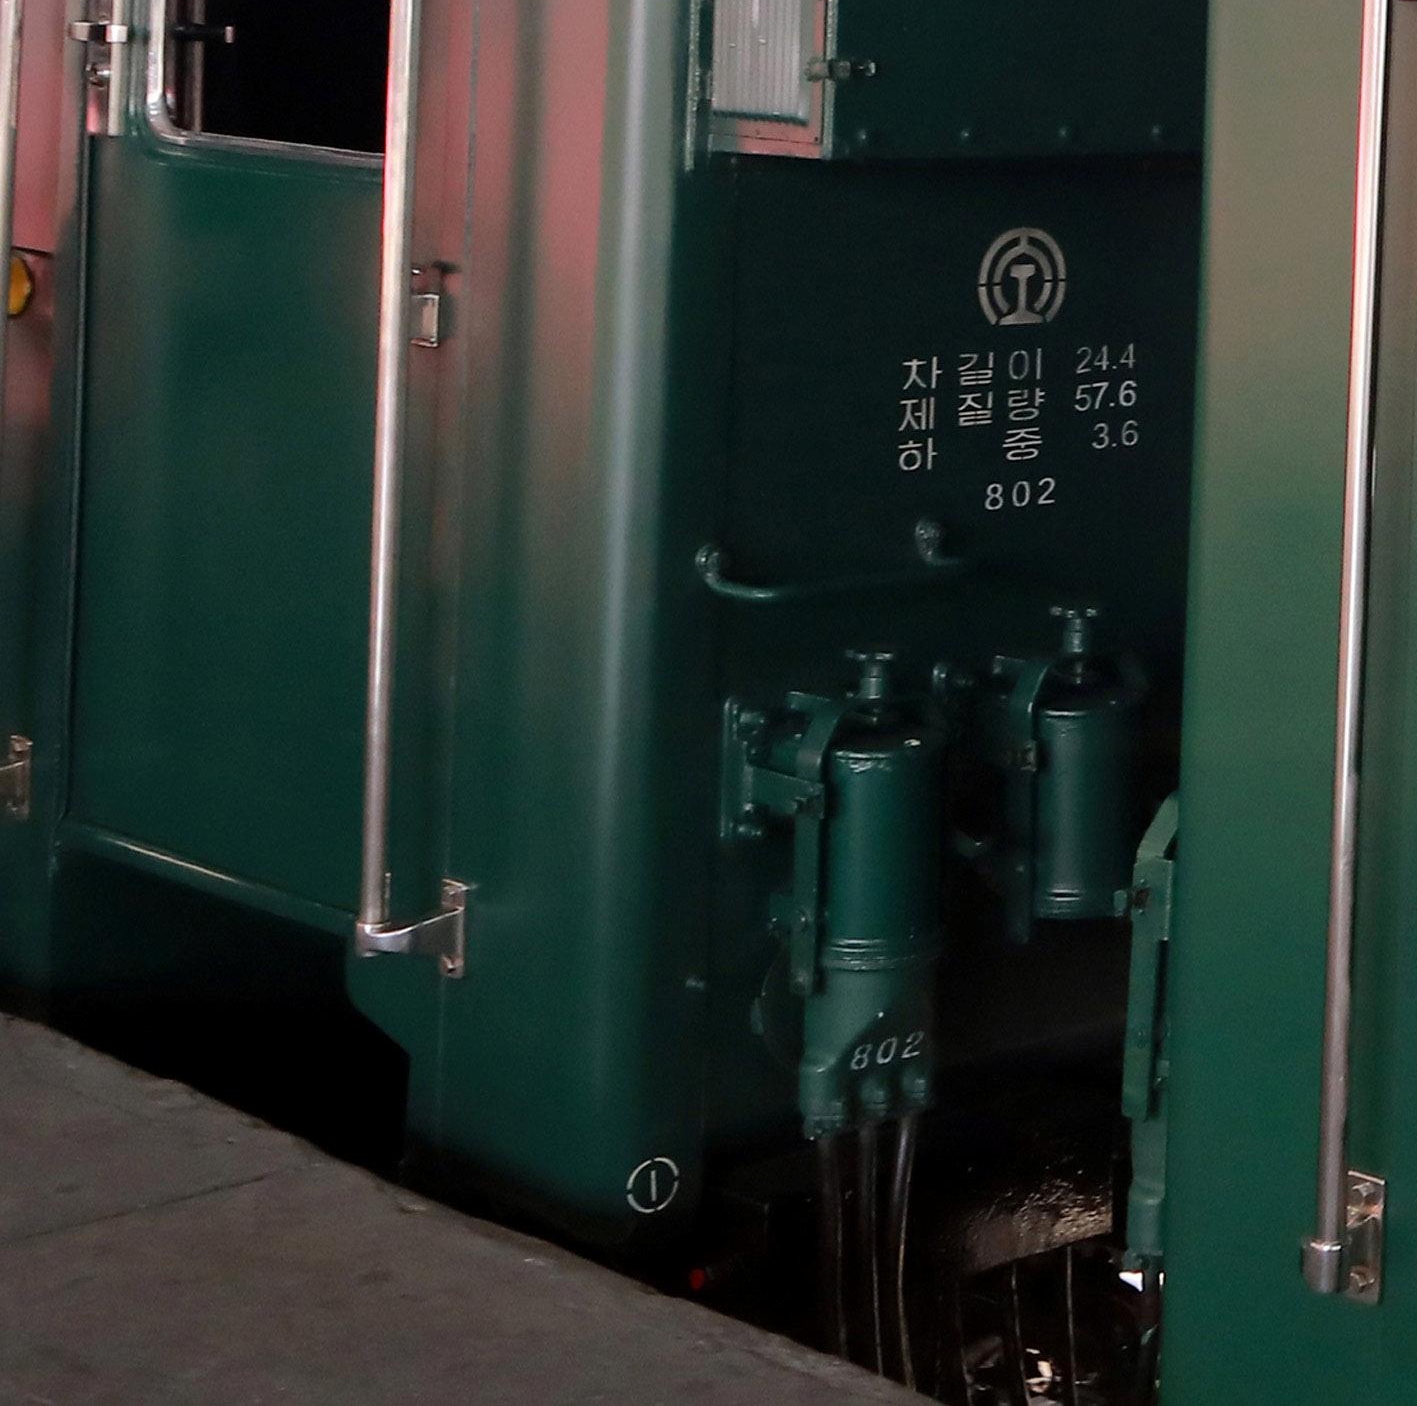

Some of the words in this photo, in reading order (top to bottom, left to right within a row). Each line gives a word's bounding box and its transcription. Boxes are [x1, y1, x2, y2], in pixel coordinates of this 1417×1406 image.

[1076, 344, 1136, 374] 24.4
[1074, 381, 1138, 412] 57.6
[1091, 420, 1138, 450] 3.6
[984, 477, 1056, 511] 802
[850, 1031, 925, 1071] 802
